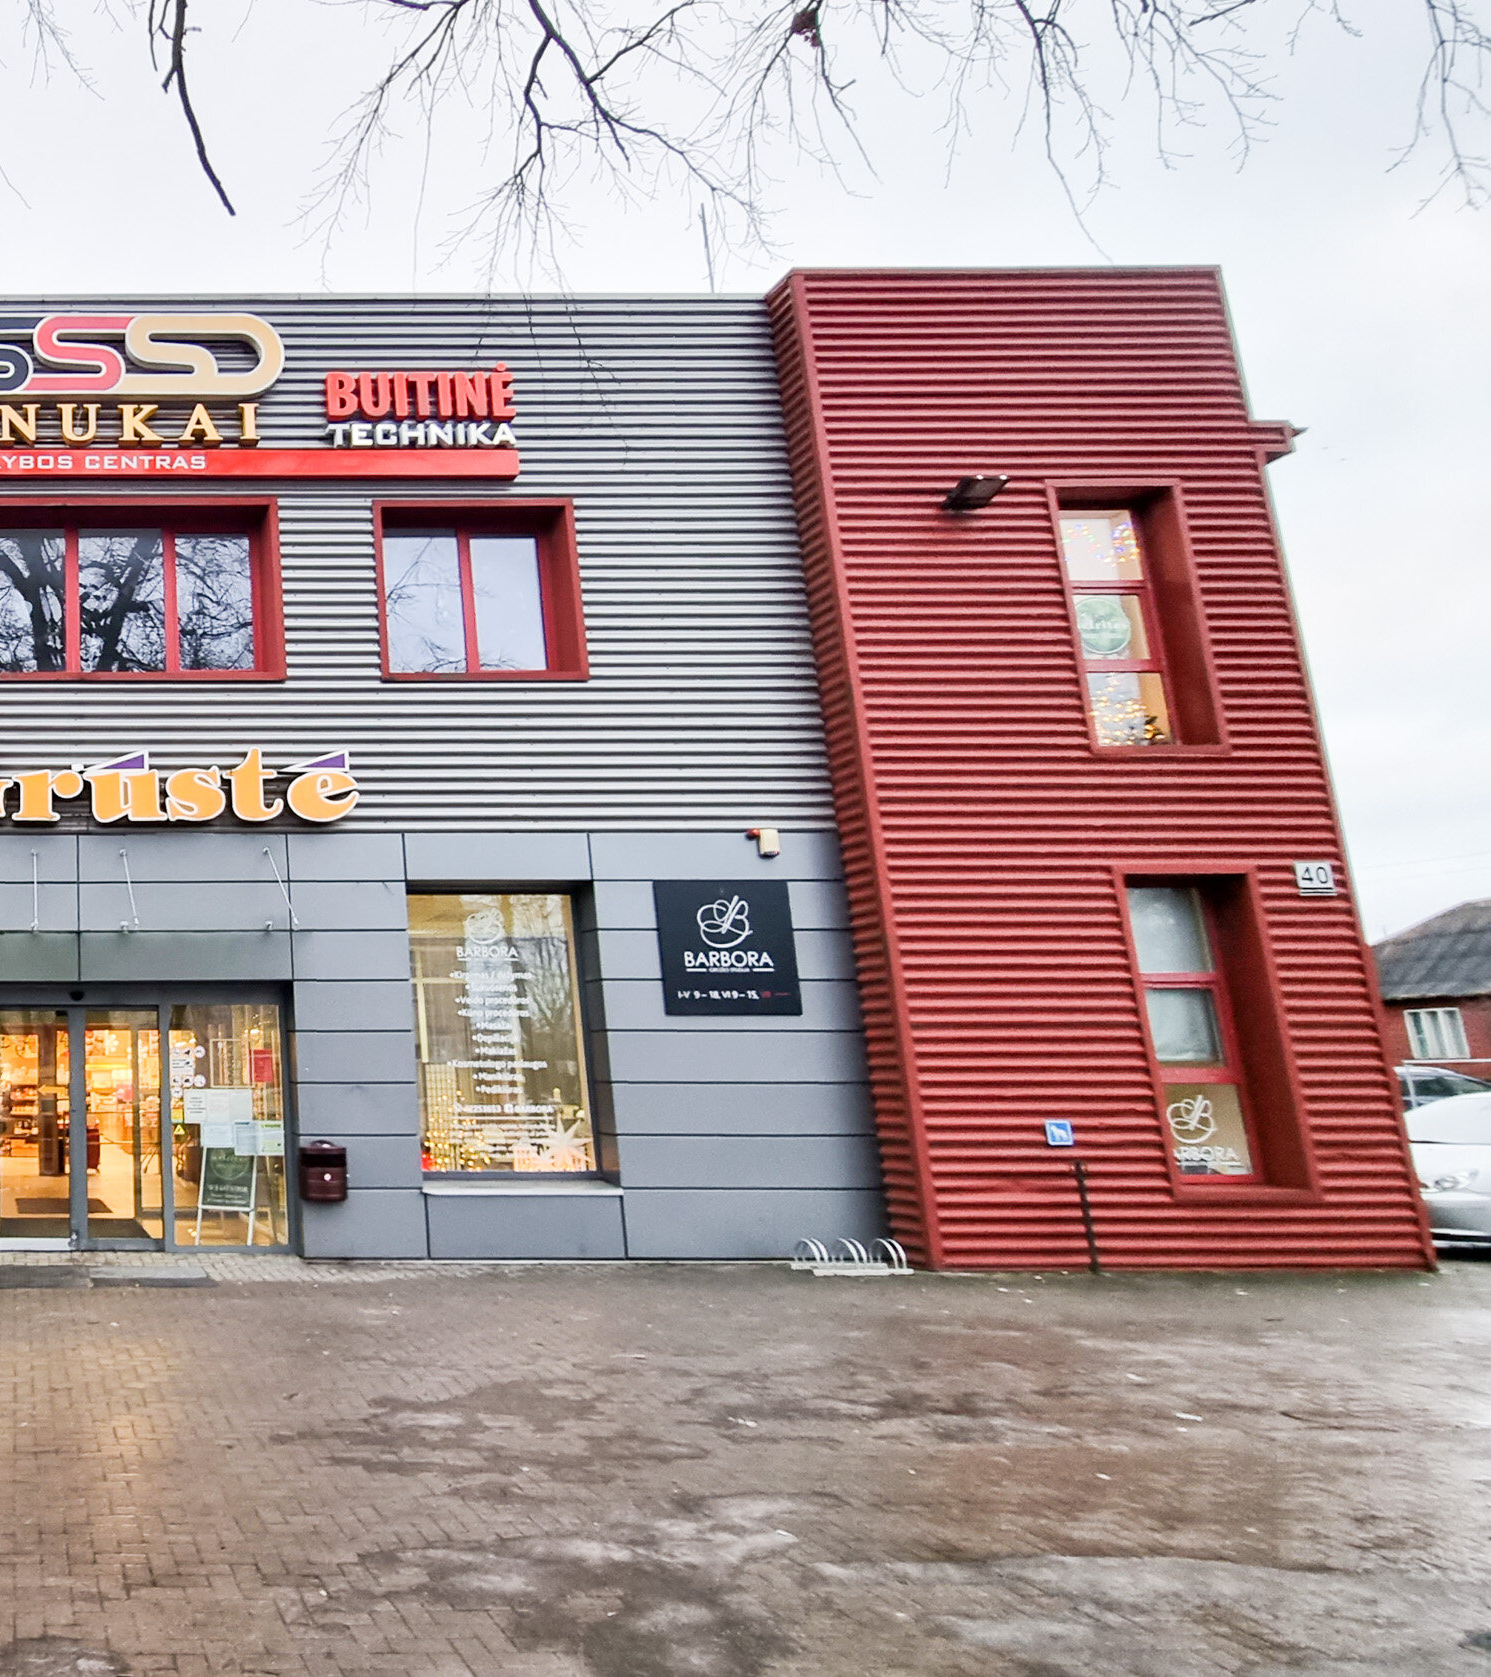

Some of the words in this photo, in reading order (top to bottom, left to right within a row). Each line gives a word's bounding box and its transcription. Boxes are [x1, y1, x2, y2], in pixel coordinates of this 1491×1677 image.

[325, 422, 517, 447] TECHNIKA
[85, 454, 206, 470] CENTRAS
[1301, 865, 1329, 884] 40
[456, 946, 518, 957] BARBORA
[684, 951, 774, 967] BARBORA
